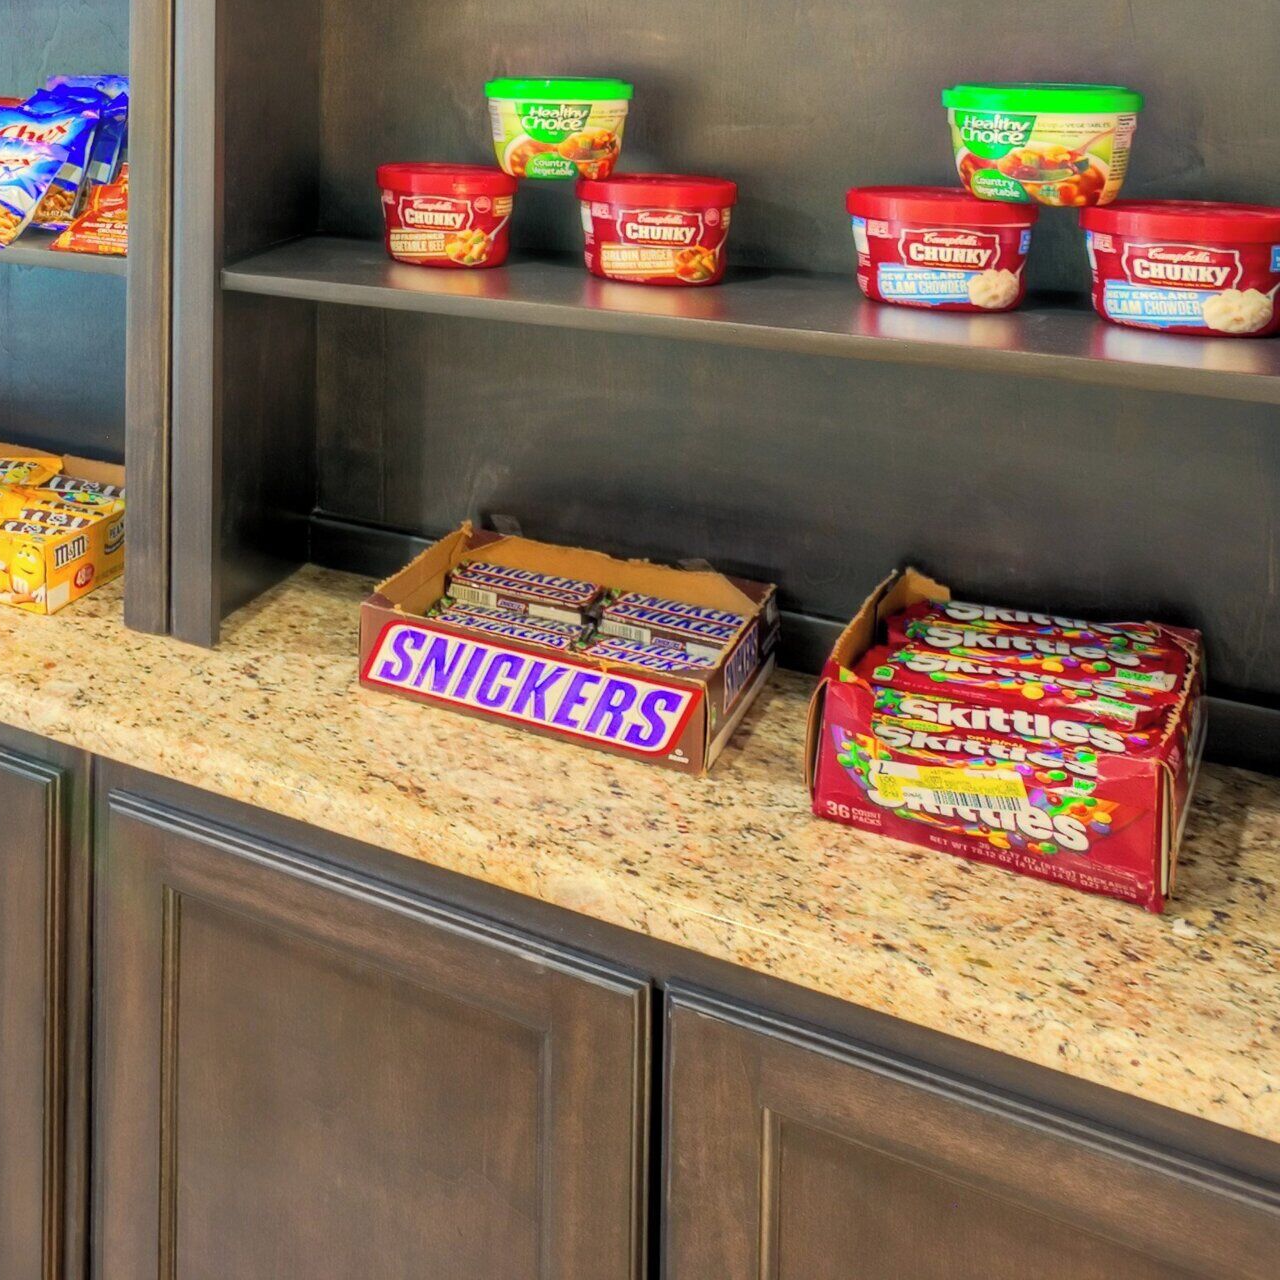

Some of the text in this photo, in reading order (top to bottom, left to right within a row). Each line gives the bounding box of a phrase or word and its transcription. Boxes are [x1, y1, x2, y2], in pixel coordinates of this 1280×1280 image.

[528, 103, 589, 122] Healthy
[521, 115, 585, 132] Choice
[964, 114, 1031, 132] Healthy
[959, 127, 1025, 147] Choice
[532, 166, 575, 178] Vegetable
[533, 158, 572, 170] Country
[974, 176, 1016, 190] Country
[974, 185, 1021, 200] Vegetable
[404, 208, 466, 229] CHUNKY
[625, 222, 697, 244] CHUNKY
[908, 244, 992, 267] CHUNKY
[881, 271, 966, 282] NEW ENGLAND
[1133, 259, 1232, 286] CHUNKY
[881, 281, 968, 295] CLAM CHOWDER
[1107, 291, 1198, 301] NEW ENGLAND
[1107, 300, 1204, 316] CLAM CHOWDER
[621, 593, 744, 627] SNICKER
[610, 604, 738, 639] SNICKER
[924, 626, 1141, 667] Skittles
[906, 654, 1128, 698] Skittles
[378, 629, 685, 750] SNICKERS
[899, 698, 1127, 753] Skittles
[876, 726, 1099, 777] Skittles
[826, 799, 882, 819] 36 COUNT
[852, 816, 882, 827] PACKS
